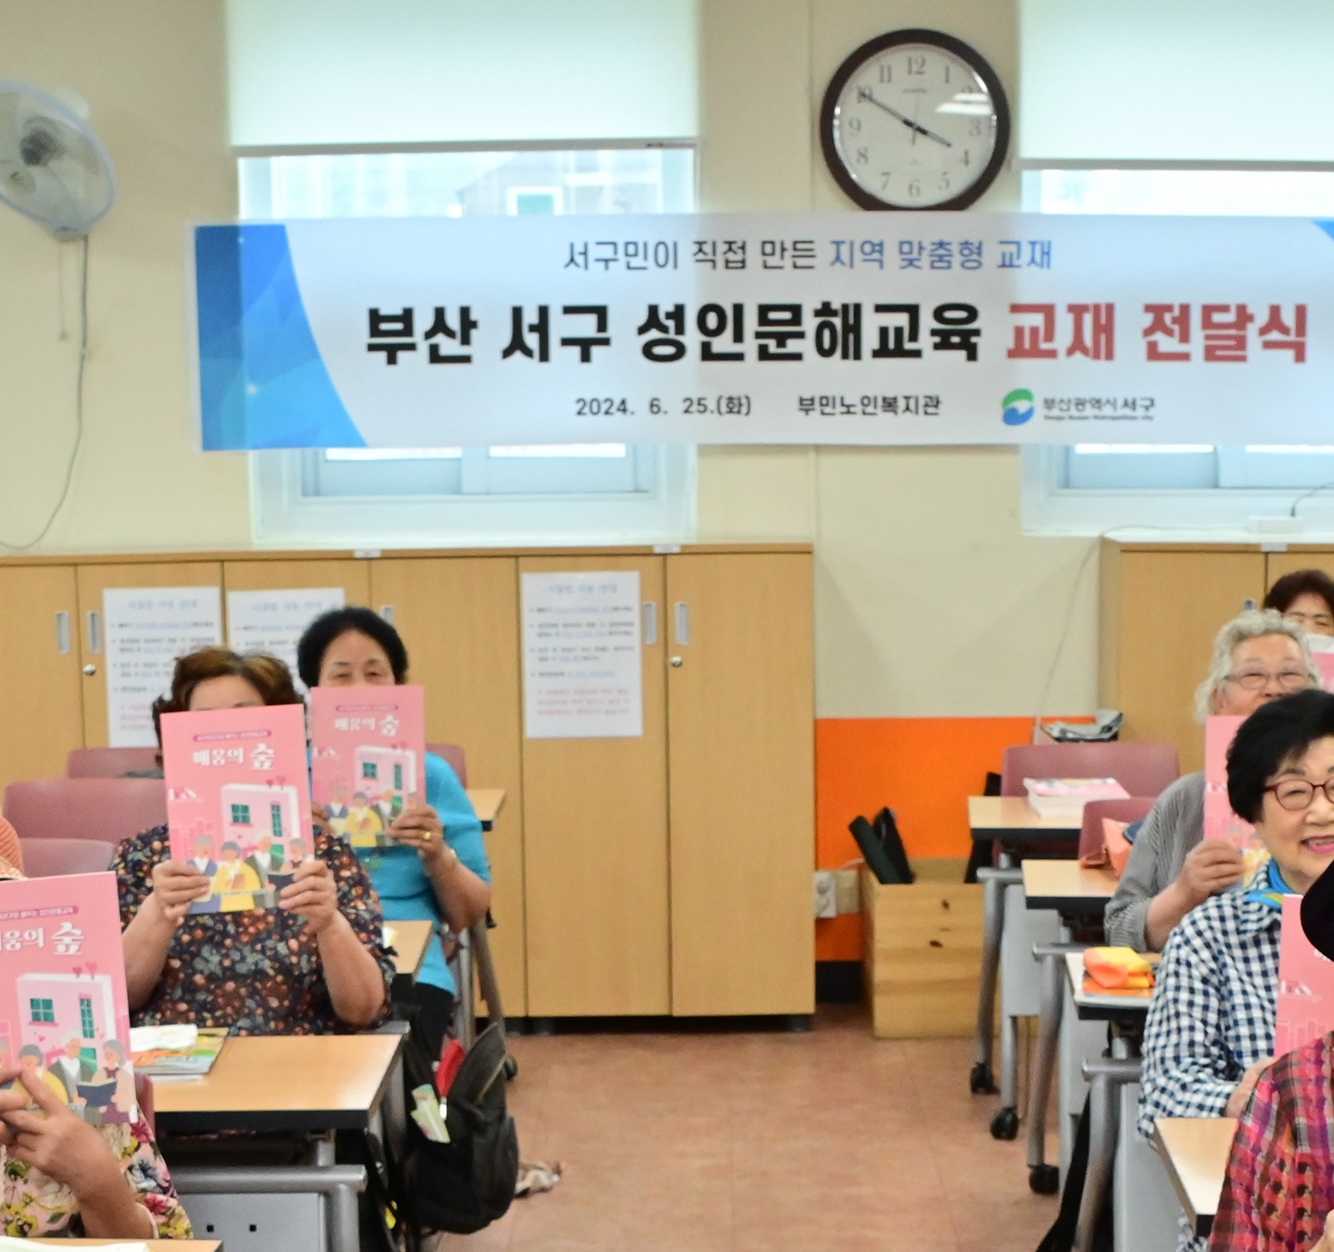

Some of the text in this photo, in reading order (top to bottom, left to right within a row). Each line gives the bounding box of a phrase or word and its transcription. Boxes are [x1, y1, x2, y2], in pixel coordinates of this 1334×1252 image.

[879, 65, 892, 83] 11
[907, 56, 926, 75] 12
[944, 65, 950, 84] 1
[848, 118, 861, 135] 9
[880, 172, 892, 190] 7
[908, 179, 921, 197] 6
[564, 239, 1053, 270] 서구민이 직접 만든 지역 맞춤형 교재
[367, 301, 1308, 365] 부산 서구 성인문해교육 교재 전달식
[575, 394, 942, 418] 2024. 6. 25.(화) 부민노인복지관
[1043, 397, 1156, 412] 부산광역시 서구
[51, 921, 85, 956] 숲
